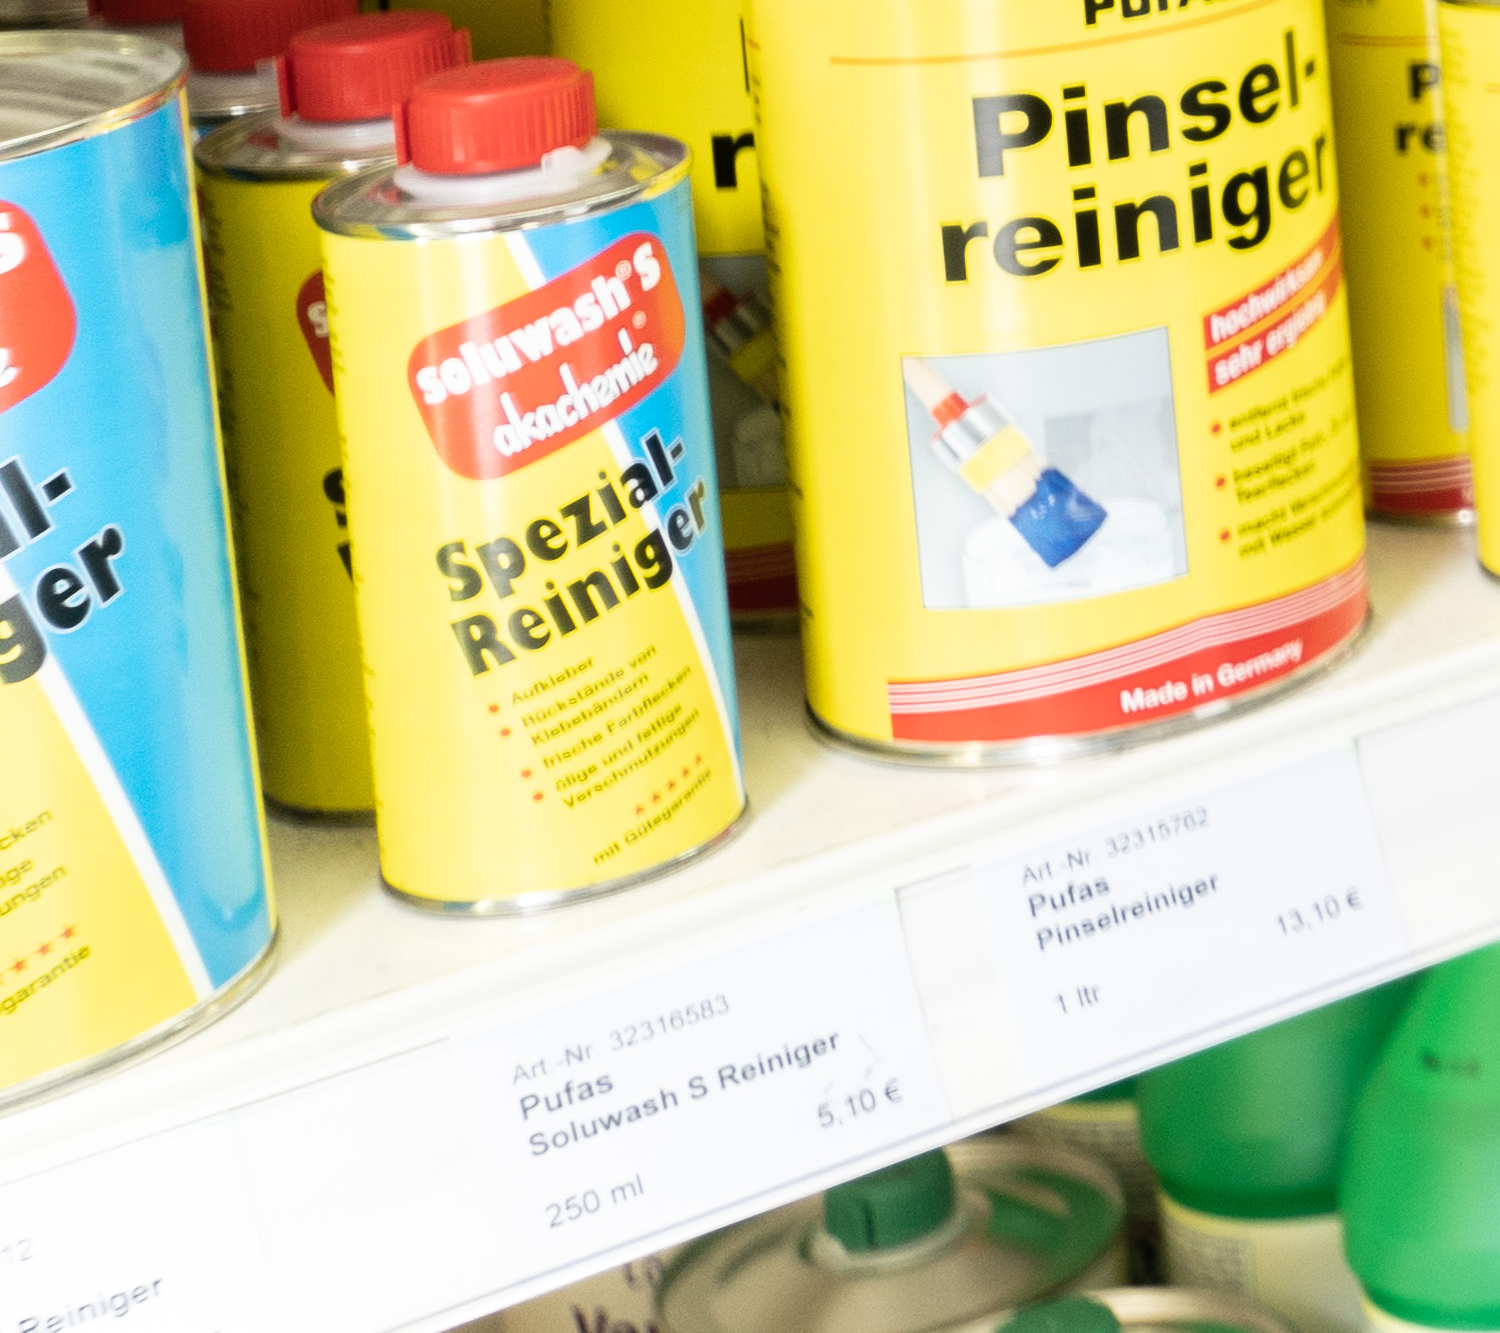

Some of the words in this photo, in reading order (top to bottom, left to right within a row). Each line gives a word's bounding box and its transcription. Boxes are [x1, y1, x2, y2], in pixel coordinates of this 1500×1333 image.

[971, 31, 1318, 179] Pinsel-
[940, 134, 1329, 285] reiniger
[435, 431, 685, 602] Spezial-
[450, 476, 707, 677] Reiniger
[512, 655, 594, 705] Aufkleber
[1119, 679, 1187, 713] Made
[1192, 674, 1212, 699] in
[1216, 638, 1303, 688] Germany
[1027, 876, 1111, 919] Pufas
[1035, 873, 1220, 952] Pinselreiniger
[609, 993, 732, 1053] 32316583
[519, 1069, 616, 1122] Pufas
[527, 1088, 680, 1158] Soluwash
[687, 1075, 710, 1101] S
[718, 1030, 841, 1090] Reiniger
[882, 1077, 904, 1105] €
[545, 1188, 601, 1231] 250
[611, 1173, 645, 1206] ml
